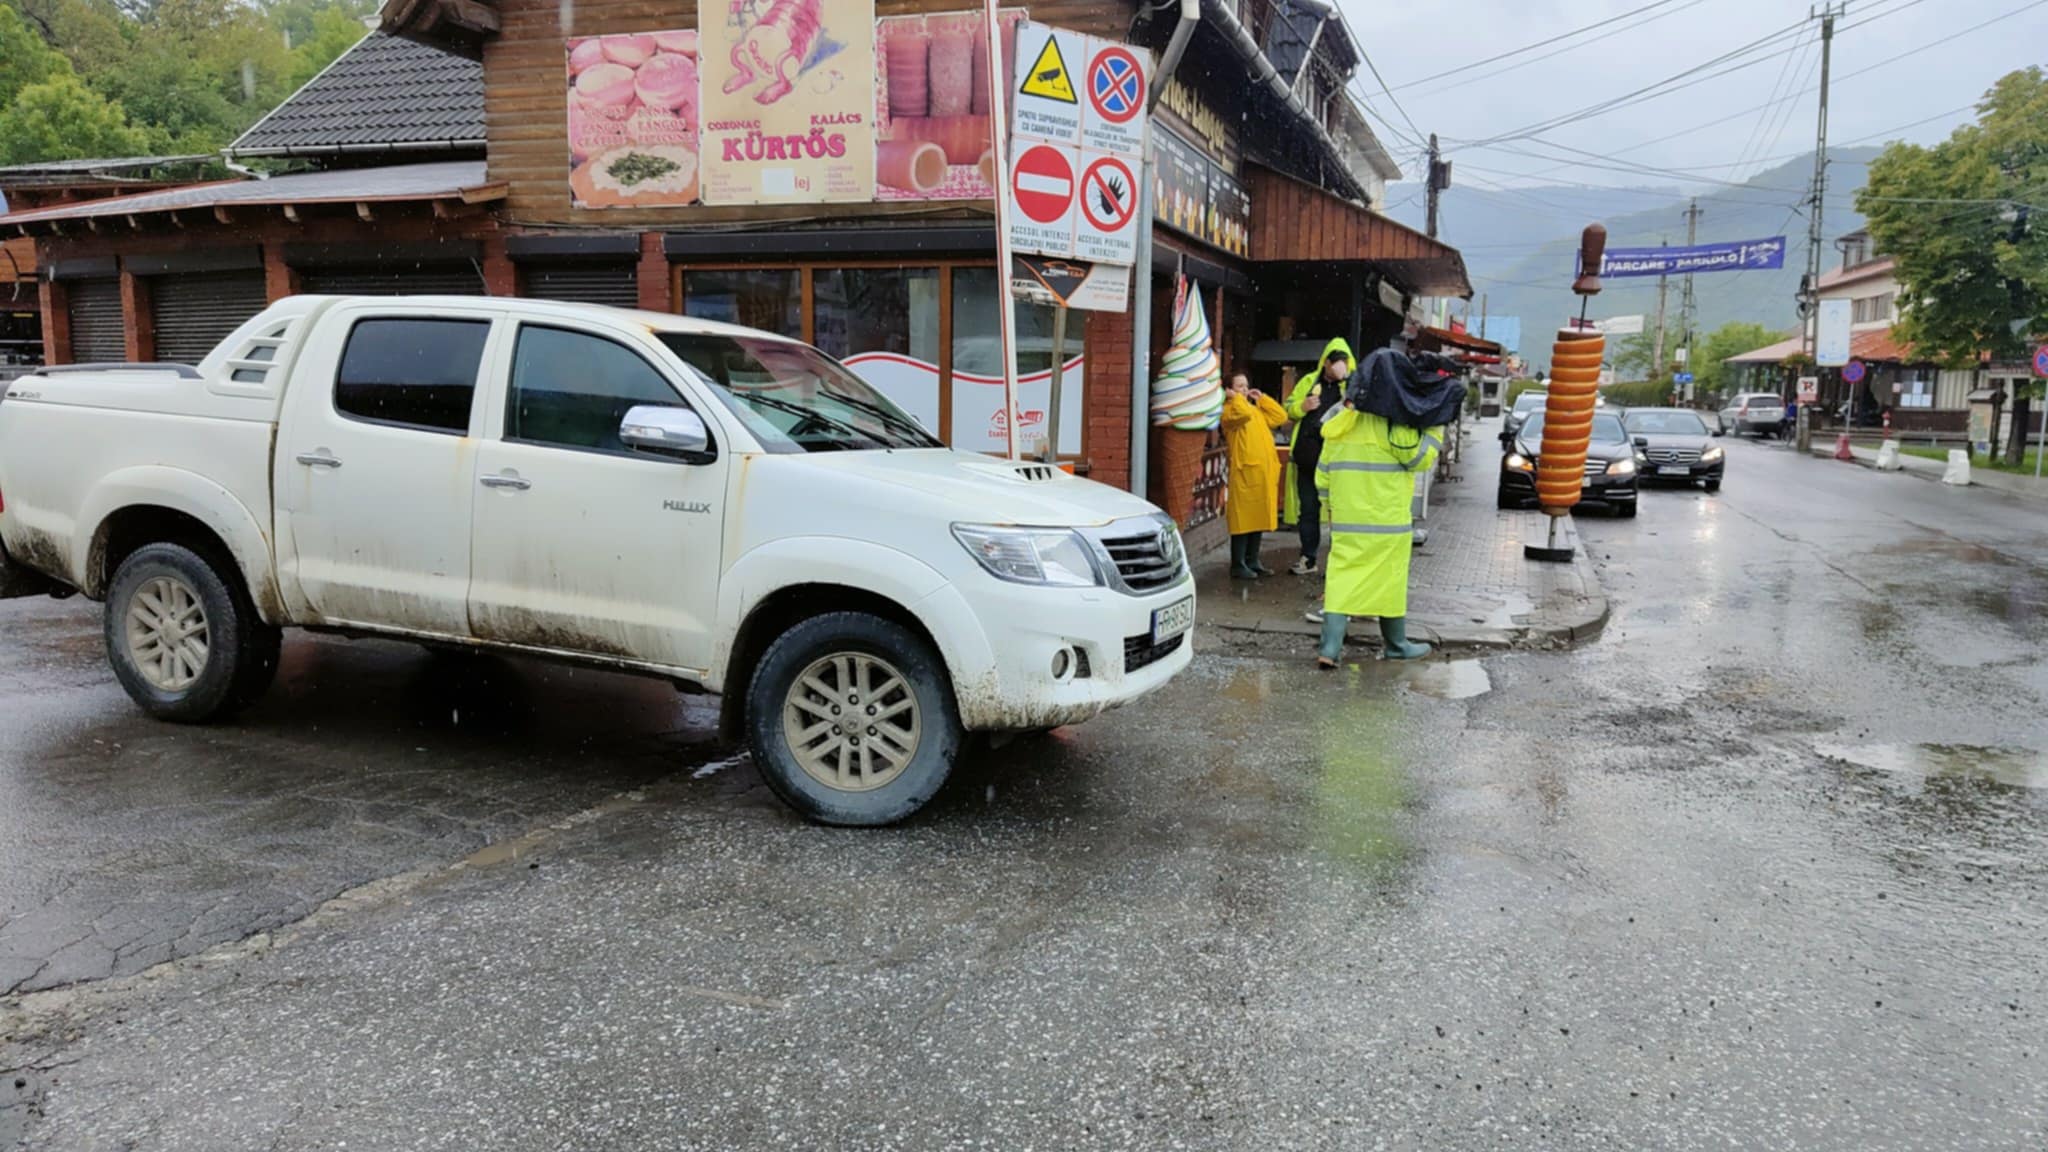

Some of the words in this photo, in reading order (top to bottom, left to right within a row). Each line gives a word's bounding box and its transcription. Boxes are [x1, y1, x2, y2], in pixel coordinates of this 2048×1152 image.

[810, 112, 862, 125] KALÁCS
[1607, 259, 1666, 272] PARCARE
[663, 499, 712, 514] HILUX
